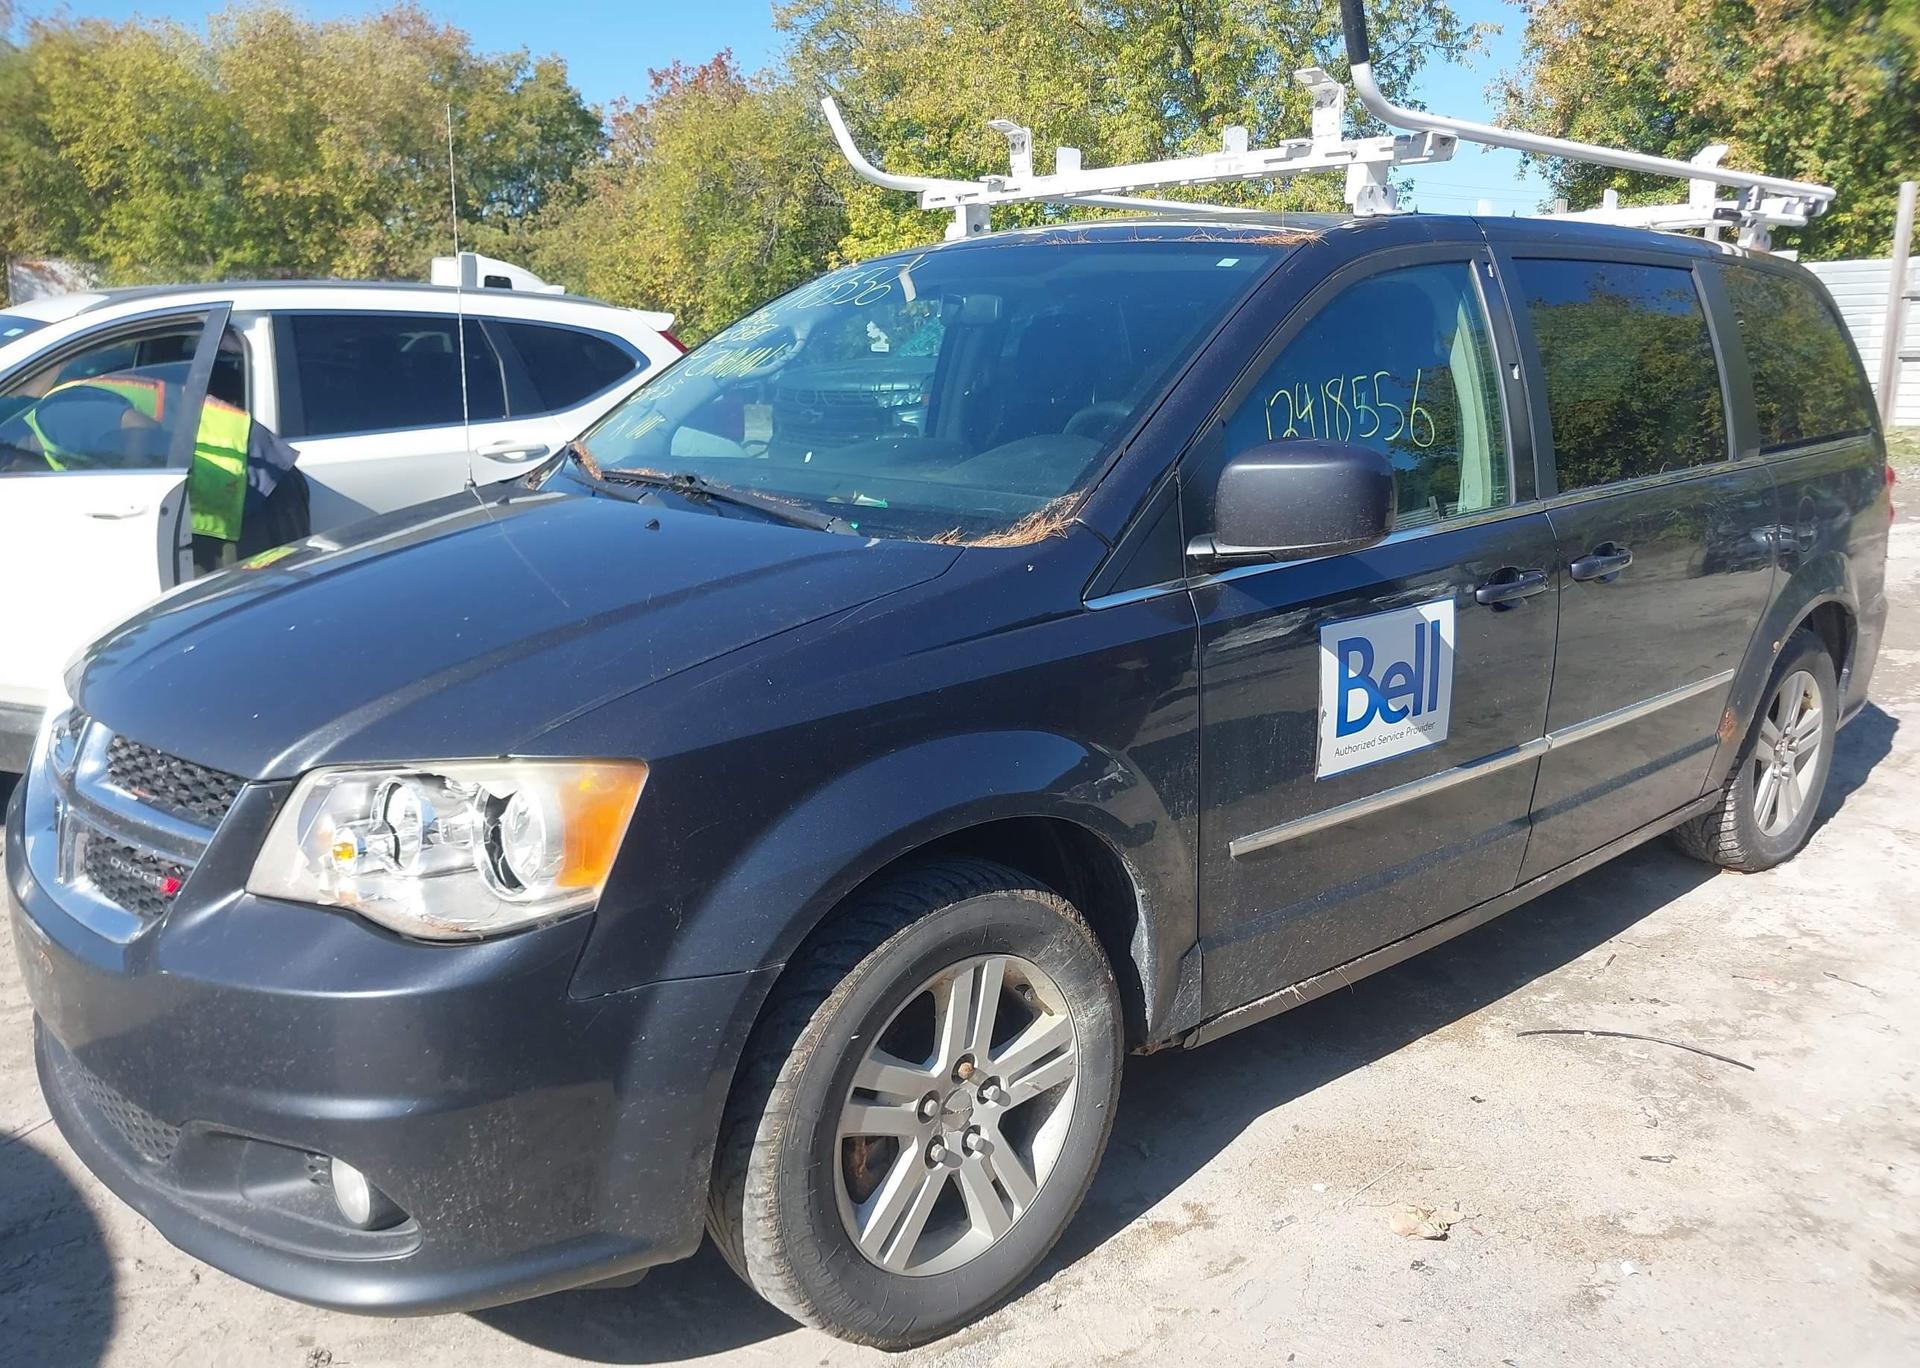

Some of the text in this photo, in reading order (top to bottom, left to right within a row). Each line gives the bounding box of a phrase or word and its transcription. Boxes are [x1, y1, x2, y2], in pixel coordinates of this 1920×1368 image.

[1265, 368, 1435, 447] 12418556
[1336, 620, 1440, 738] Bell
[1334, 720, 1436, 758] Authorized Service Provider
